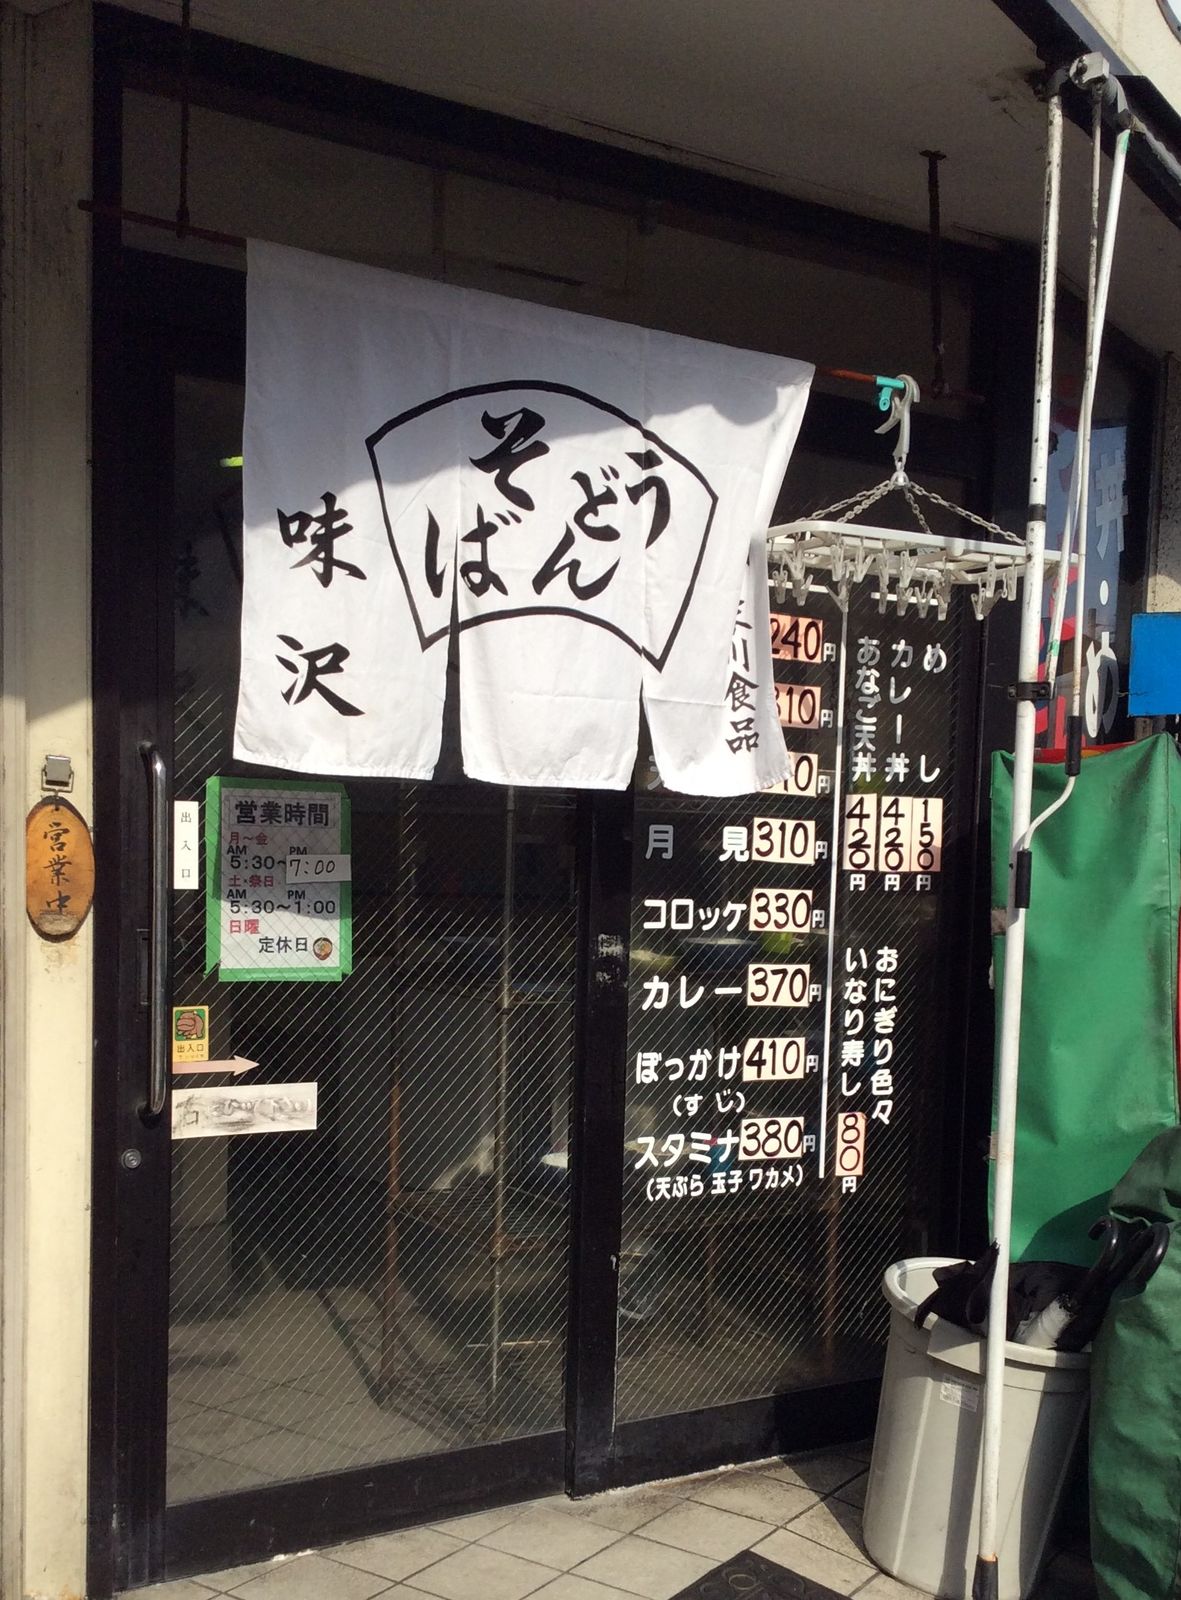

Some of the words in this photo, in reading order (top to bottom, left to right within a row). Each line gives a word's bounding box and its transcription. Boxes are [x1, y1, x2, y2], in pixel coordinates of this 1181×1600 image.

[425, 407, 550, 599] そば
[532, 449, 671, 601] うどん
[276, 491, 367, 717] 味沢
[852, 635, 882, 783] あなご天丼
[885, 639, 913, 783] カレー丼
[234, 800, 330, 827] 営業時間
[180, 811, 193, 880] 出入口
[226, 845, 248, 856] AM
[289, 846, 308, 856] PM
[43, 821, 73, 915] 営業中
[226, 889, 247, 900] AM
[288, 889, 306, 900] PM
[229, 918, 260, 934] 日曜
[644, 899, 747, 932] コロッケ
[259, 936, 308, 954] 定休日
[642, 976, 743, 1010] カレー
[842, 948, 867, 1097] いなり寿し
[871, 946, 899, 1125] おにぎり色々
[176, 1043, 204, 1053] 出入口
[635, 1046, 741, 1084] ぼっかけ
[635, 1129, 740, 1169] スタミナ
